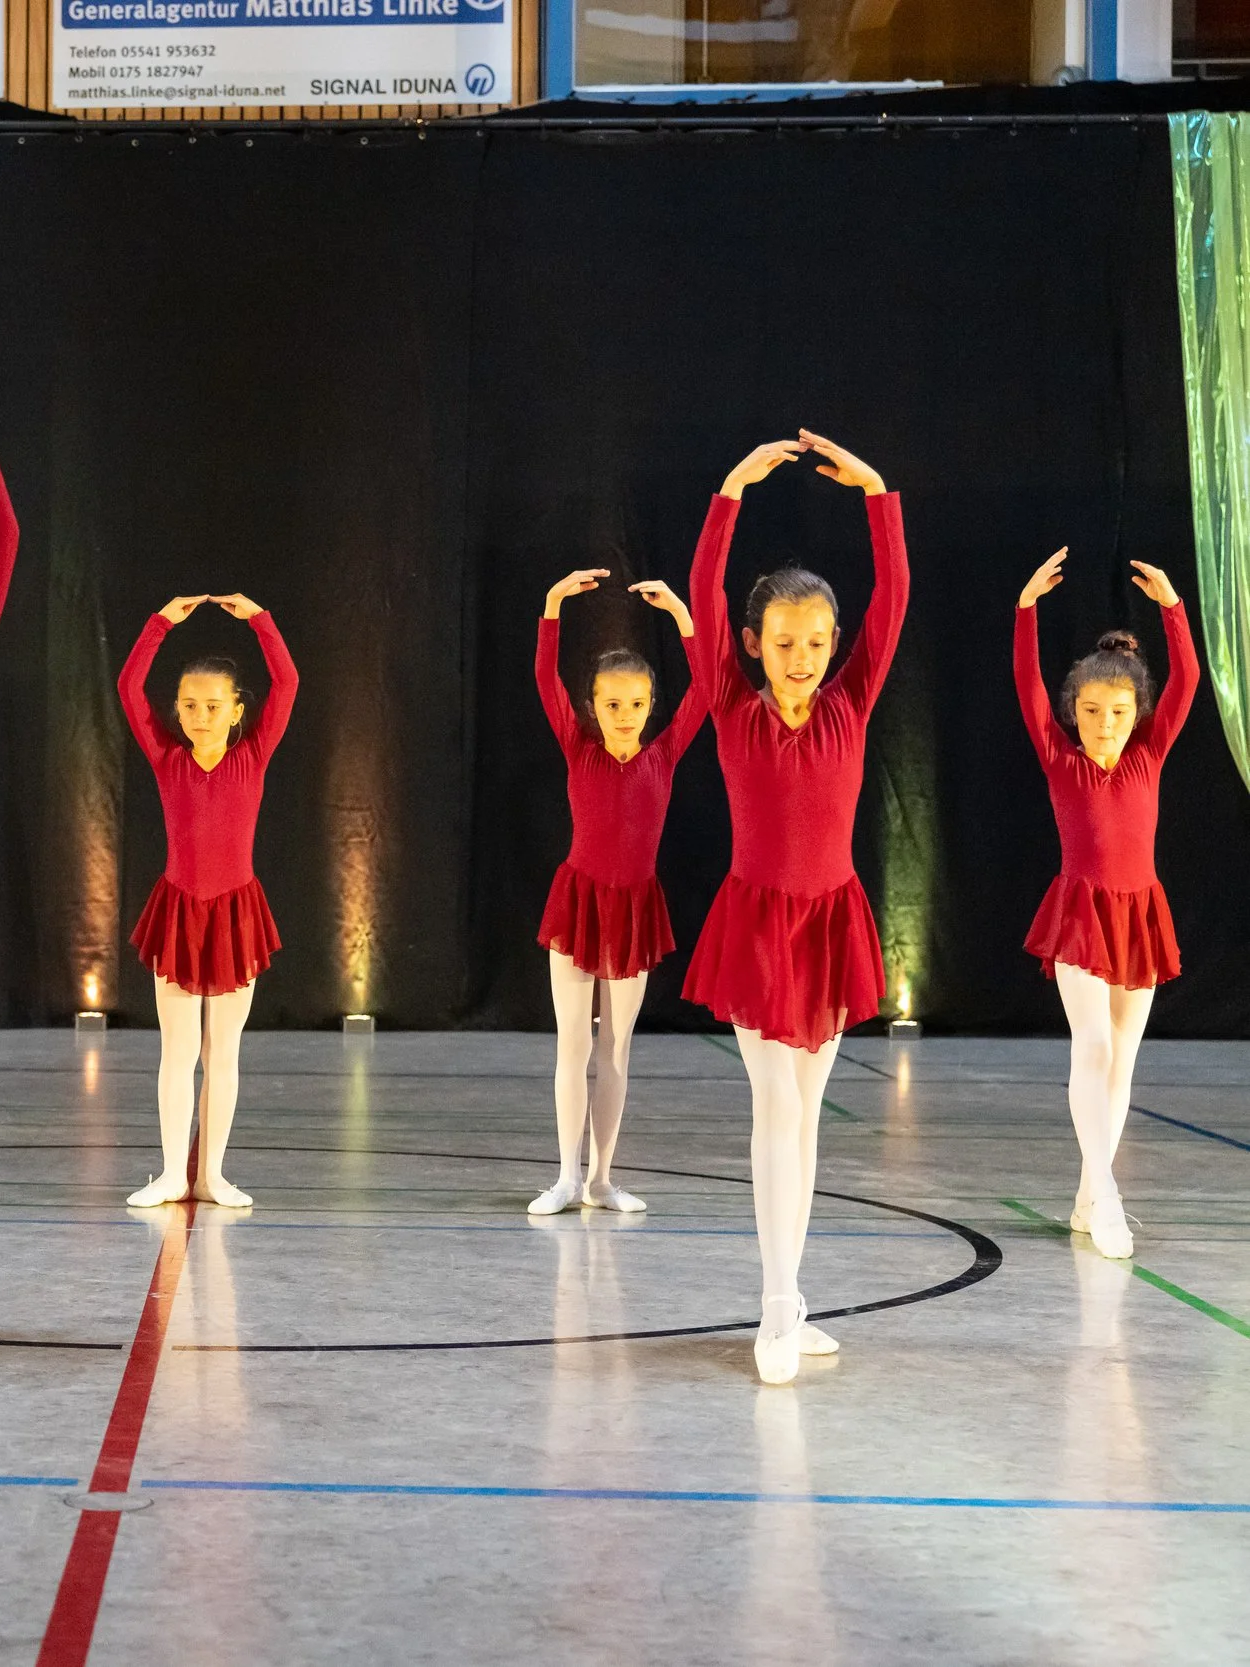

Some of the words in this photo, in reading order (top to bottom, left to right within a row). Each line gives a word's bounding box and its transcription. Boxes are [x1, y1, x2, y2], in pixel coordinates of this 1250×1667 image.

[68, 0, 239, 23] Generalagentur
[246, 0, 373, 17] Matthias
[383, 0, 459, 16] Linke
[70, 46, 117, 58] Telefon
[121, 46, 161, 58] 05541
[166, 45, 216, 57] 953632
[68, 66, 106, 79] Mobil
[109, 67, 141, 78] 0175
[147, 65, 204, 78] 1827947
[68, 84, 286, 100] matthias.linke@signal-iduna.net
[310, 79, 387, 96] SIGNAL
[393, 78, 457, 95] IDUNA
